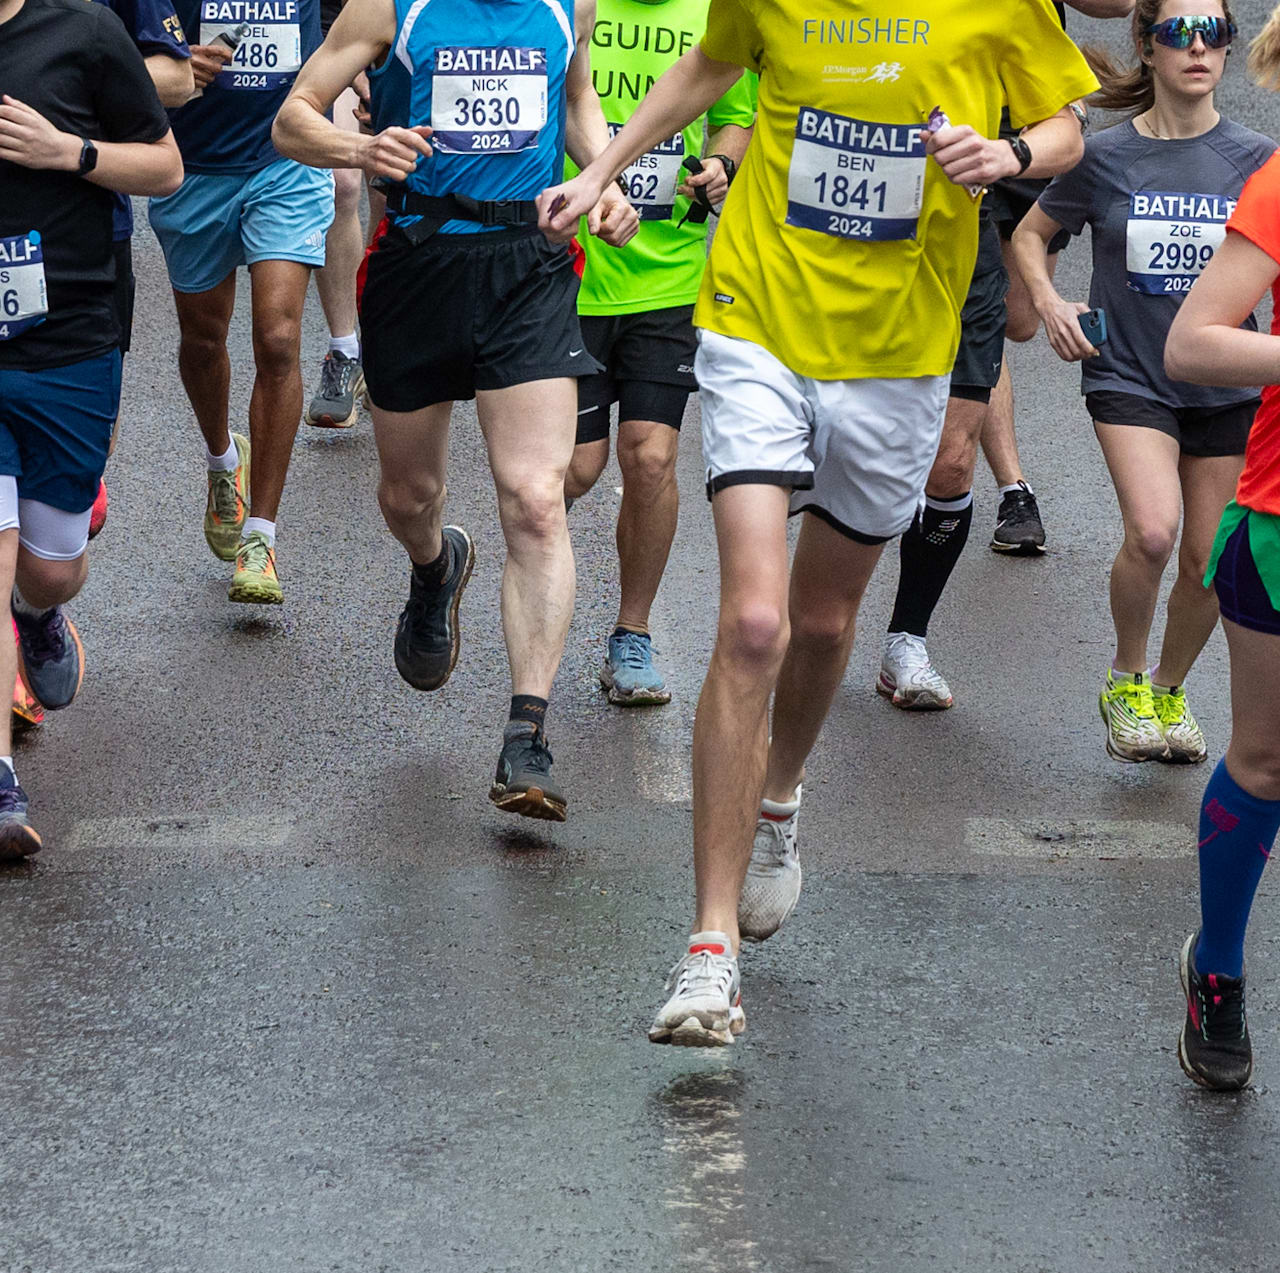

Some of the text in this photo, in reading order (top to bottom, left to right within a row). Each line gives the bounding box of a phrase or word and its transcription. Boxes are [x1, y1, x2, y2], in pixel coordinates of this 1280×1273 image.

[205, 1, 297, 21] BATHALF
[242, 27, 269, 38] OEL
[592, 20, 694, 56] GUIDE
[803, 17, 930, 45] FINISHER
[230, 42, 278, 68] 486
[438, 49, 543, 72] BATHALF
[233, 75, 268, 88] 2024
[472, 78, 508, 92] NICK
[454, 97, 520, 127] 3630
[472, 134, 511, 149] 2024
[801, 110, 923, 153] BATHALF
[837, 154, 875, 172] BEN
[627, 173, 659, 200] 62
[814, 171, 887, 213] 1841
[1133, 195, 1238, 220] BATHALF
[828, 215, 873, 237] 2024
[1170, 224, 1202, 238] ZOE
[1148, 242, 1214, 271] 2999
[677, 364, 694, 373] 2X
